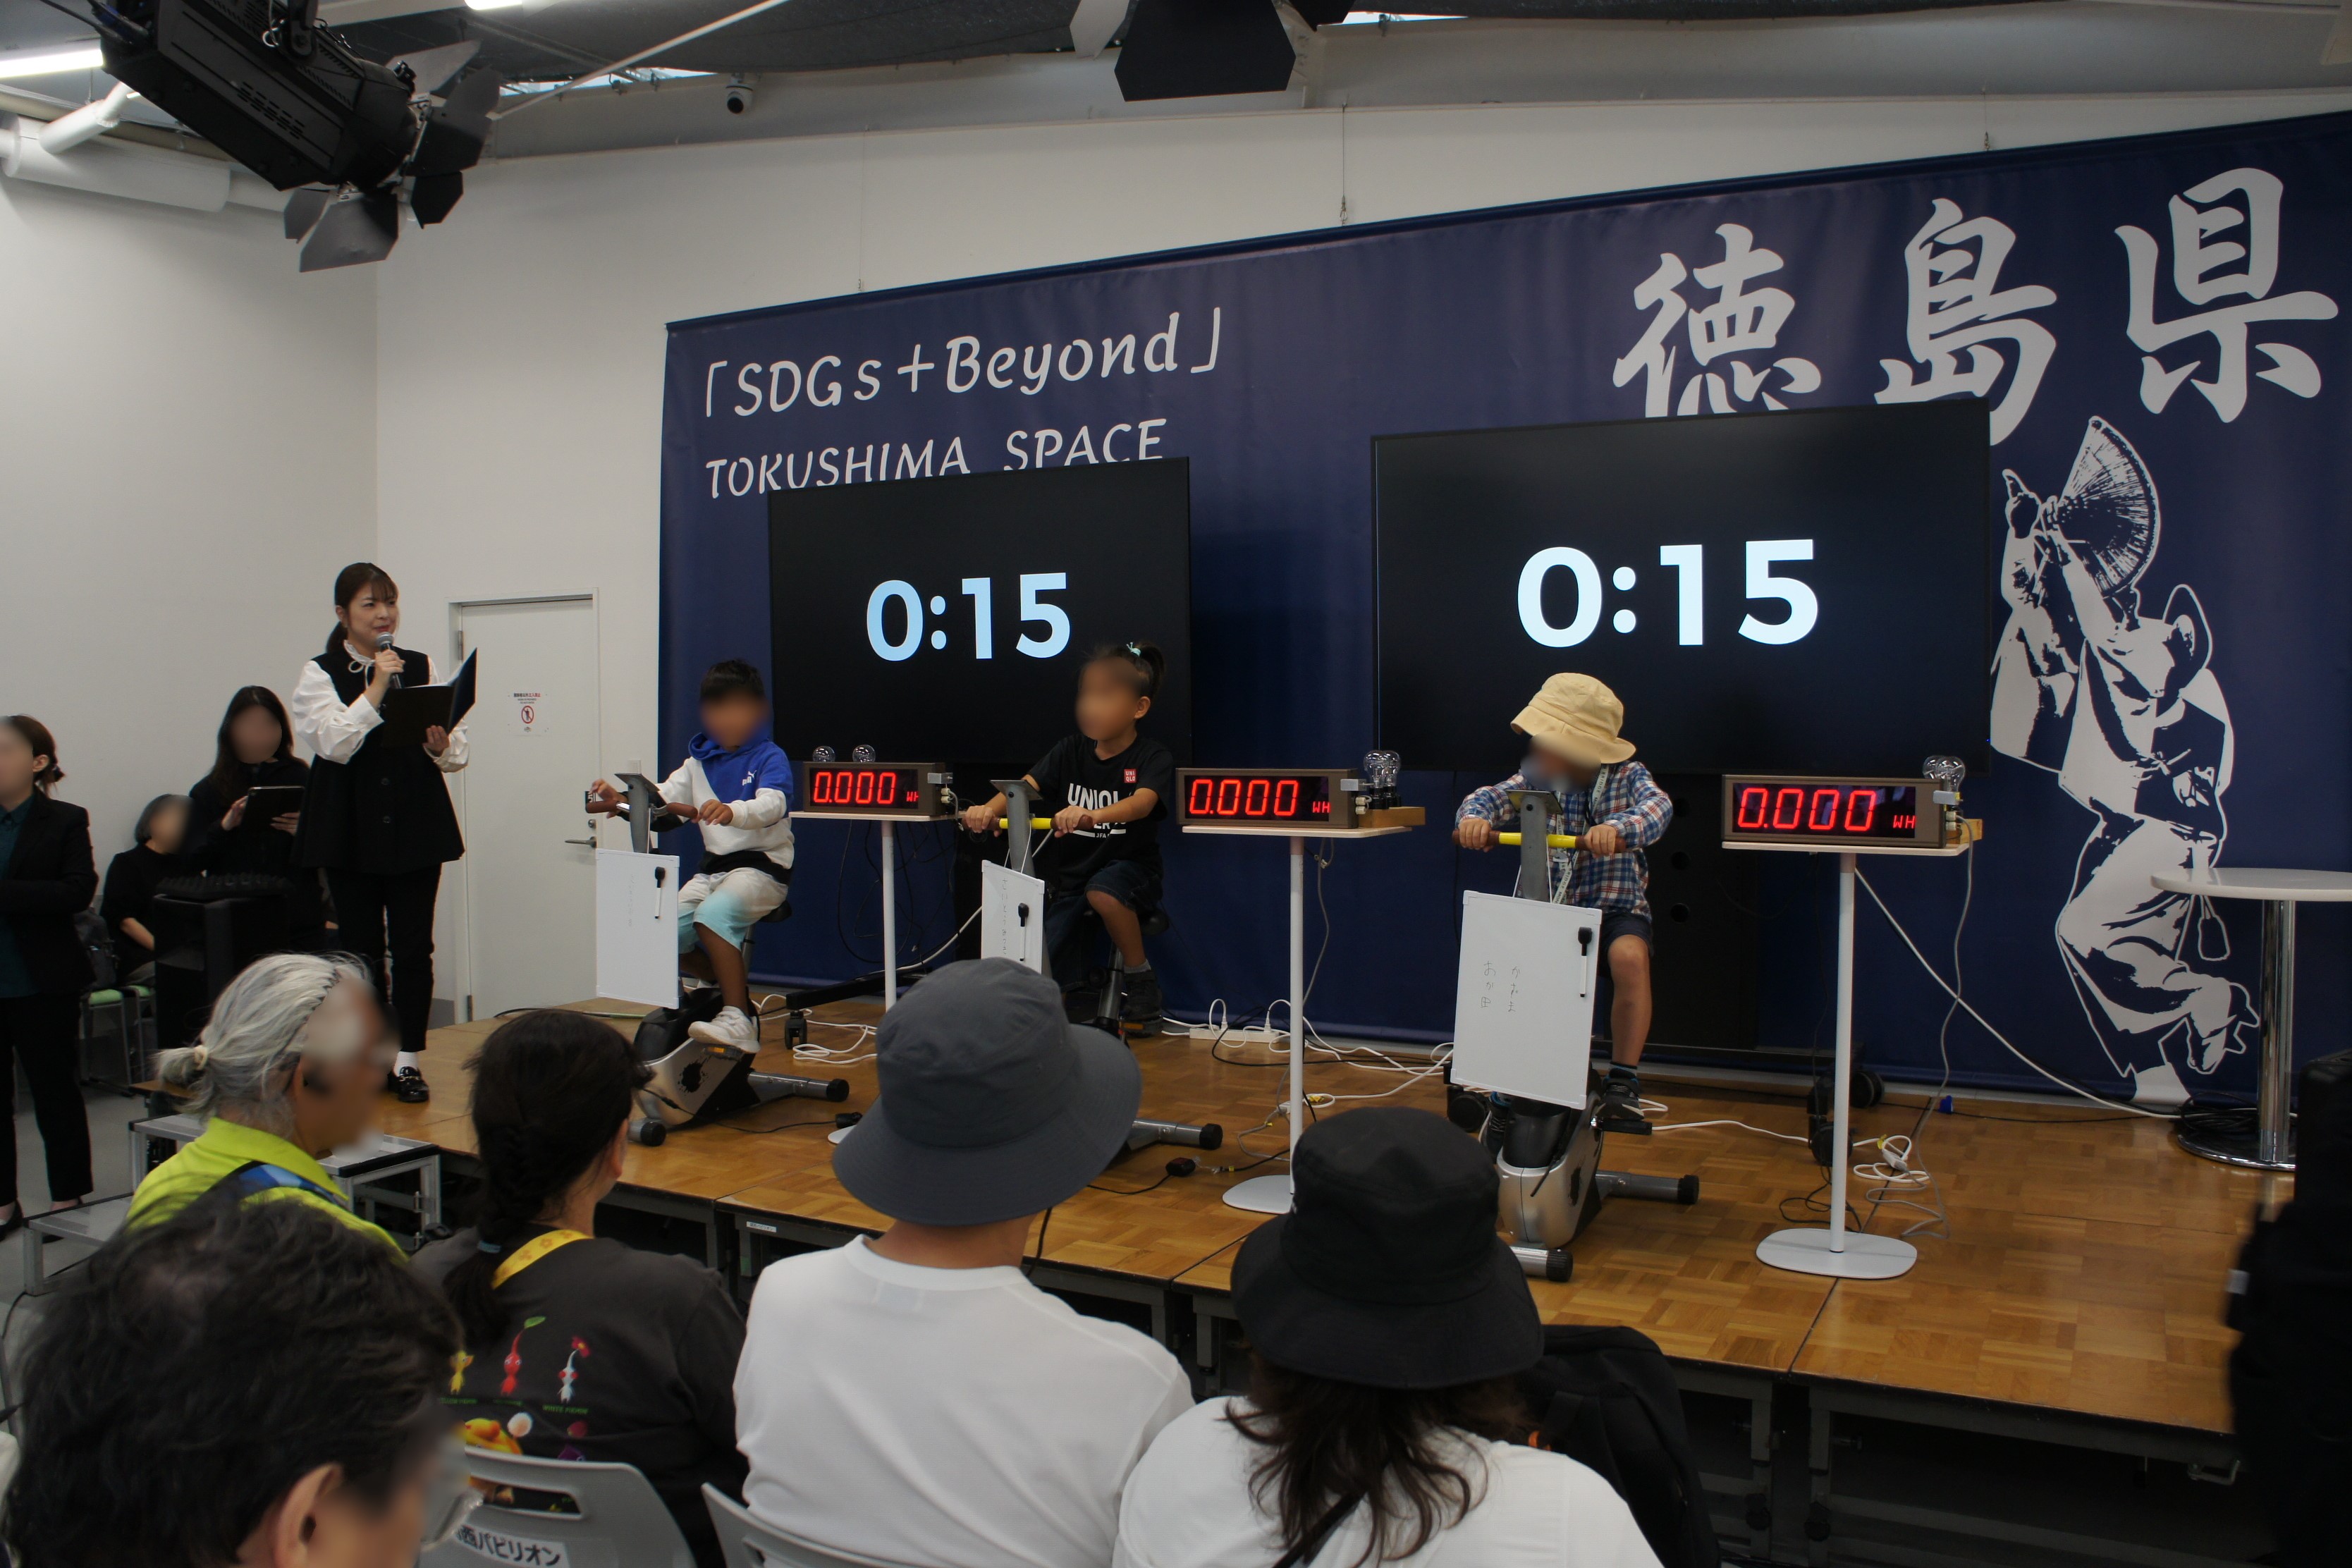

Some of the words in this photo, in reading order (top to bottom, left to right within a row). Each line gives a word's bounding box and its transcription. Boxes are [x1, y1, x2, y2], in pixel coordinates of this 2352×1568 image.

[1612, 167, 2339, 446] 徳島県
[706, 436, 971, 498] TOKUSHIMA
[1003, 418, 1168, 472] SPACE
[866, 572, 1071, 661] 0:15
[1517, 538, 1820, 648] 0:15
[814, 771, 897, 804] 0.000
[1189, 779, 1299, 816] 0.000
[1312, 801, 1331, 814] WH
[1737, 787, 1877, 832] 0.000
[1892, 814, 1916, 829] WH
